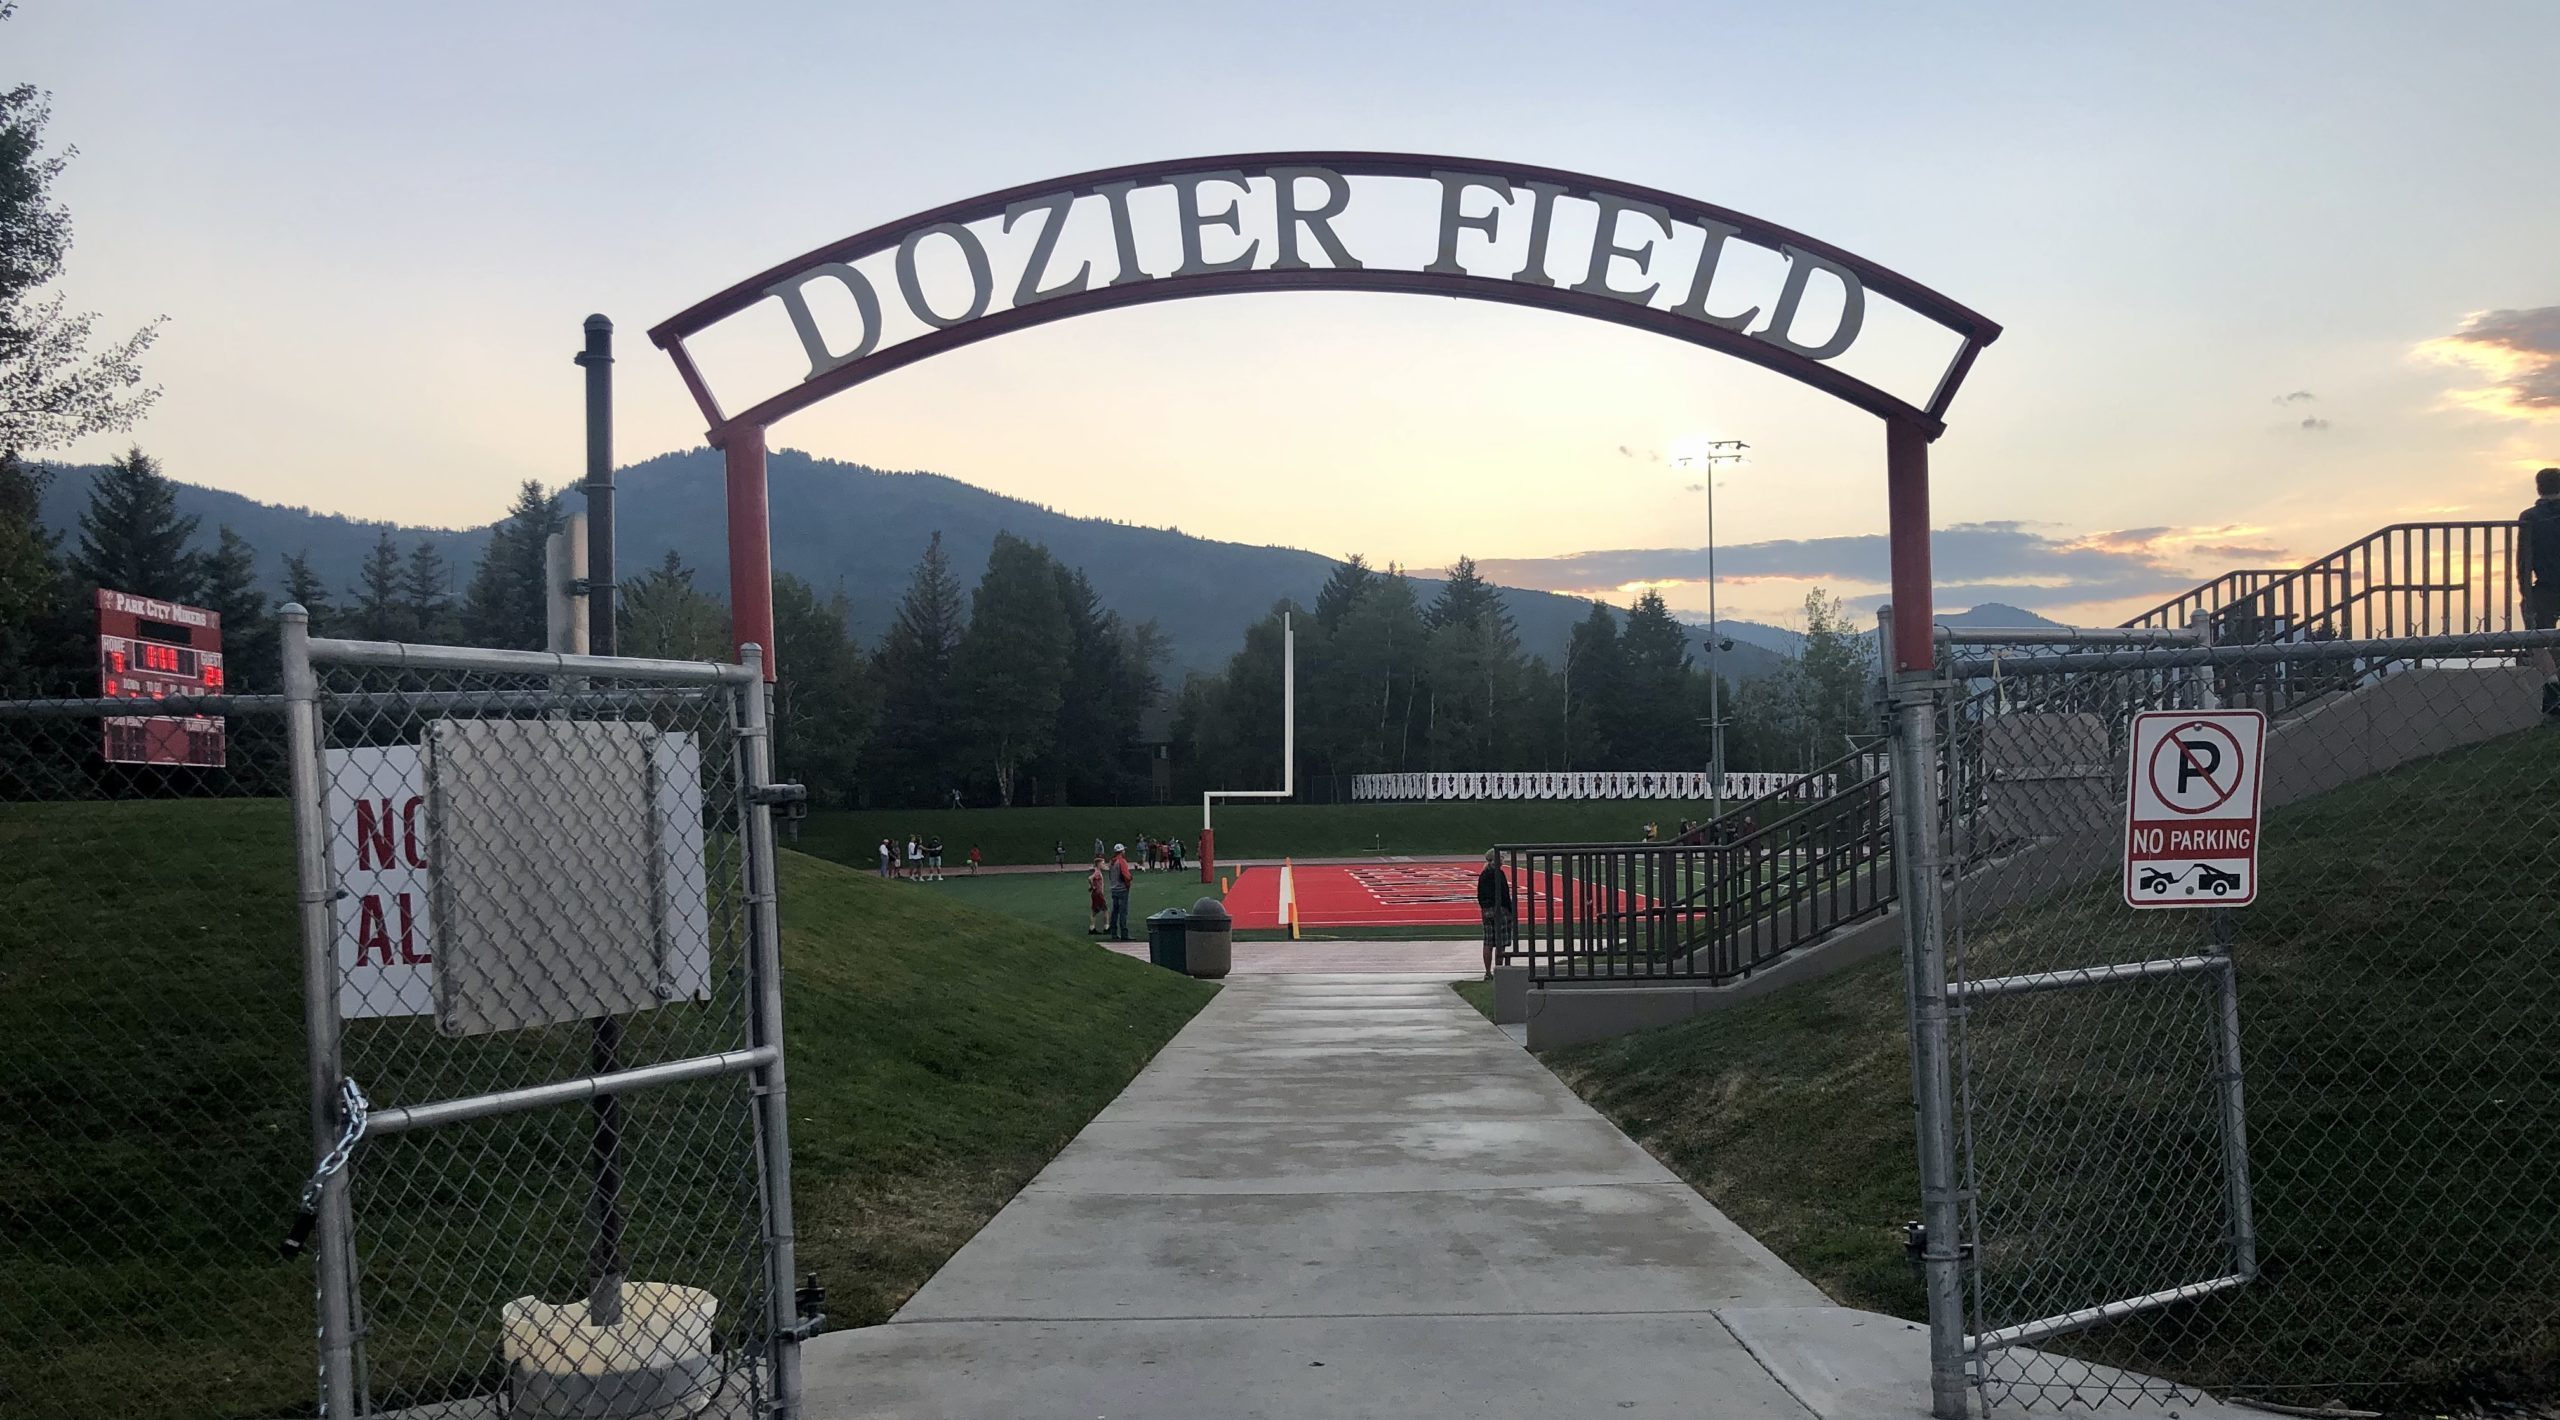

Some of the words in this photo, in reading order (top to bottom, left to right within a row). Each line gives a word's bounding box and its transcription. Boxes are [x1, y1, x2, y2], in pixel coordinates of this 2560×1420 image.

[763, 166, 1363, 383] DOZIER
[1424, 170, 1866, 361] FIELD
[116, 593, 145, 615] PARK
[147, 600, 171, 620] CITY
[172, 604, 207, 627] MINERS
[103, 638, 125, 653] HOME
[2177, 740, 2221, 794] P
[2133, 828, 2165, 855] NO
[2170, 828, 2251, 851] PARKING
